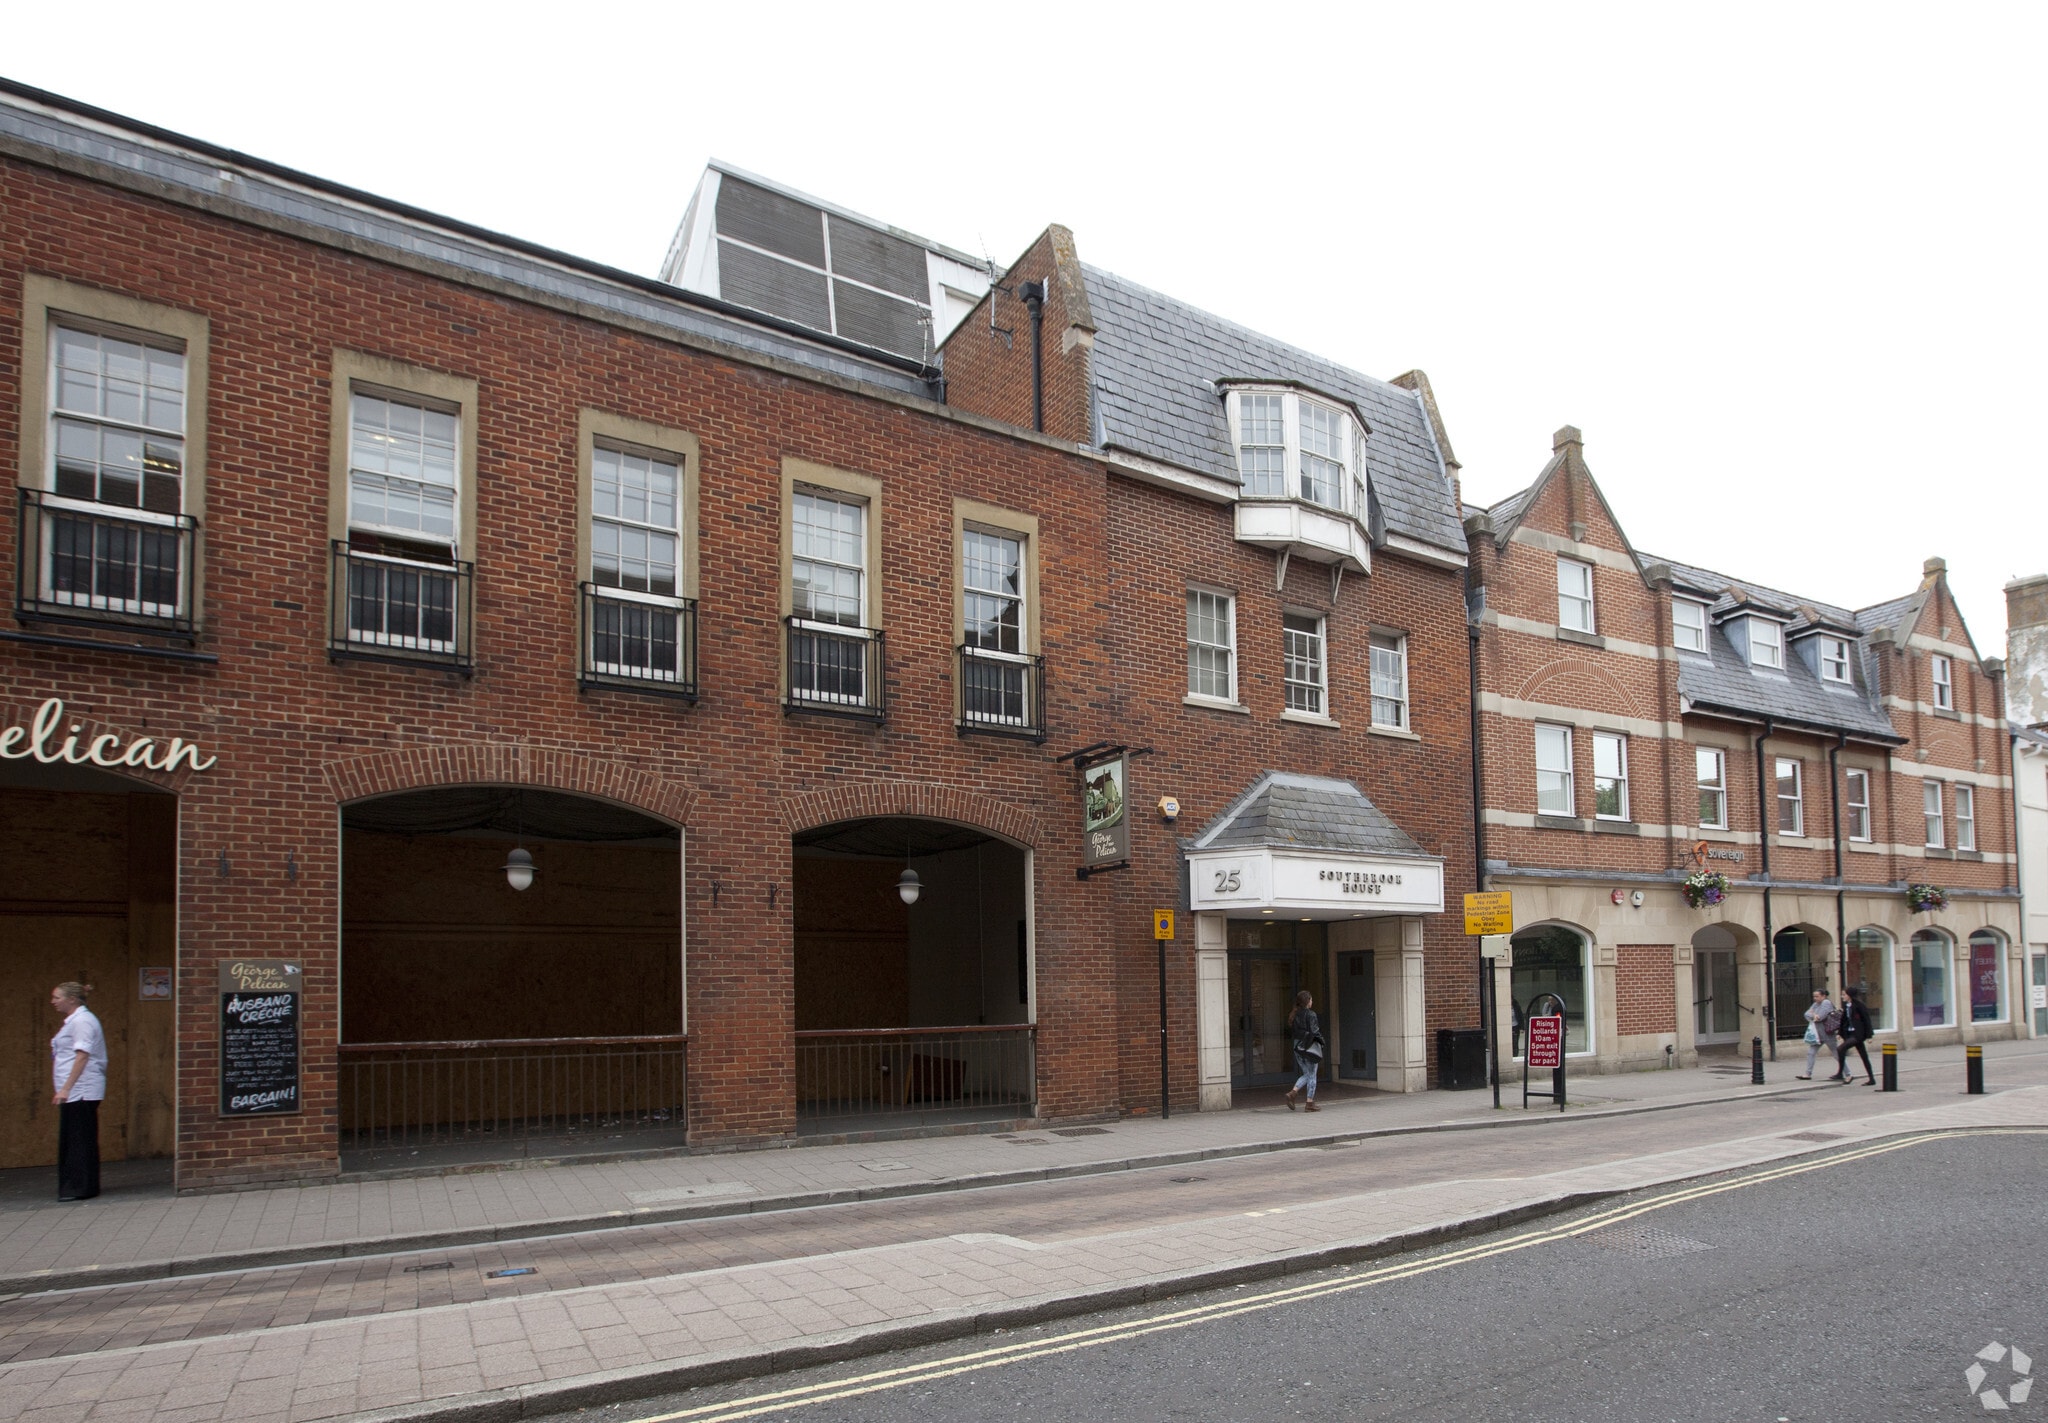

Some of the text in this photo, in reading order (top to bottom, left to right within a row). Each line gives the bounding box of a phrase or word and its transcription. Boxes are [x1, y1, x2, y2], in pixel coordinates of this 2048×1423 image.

[1708, 849, 1745, 863] sovereign
[1214, 869, 1241, 892] 25
[1319, 870, 1402, 884] SOUTHBROOK
[1343, 882, 1382, 895] HOUSE
[231, 963, 279, 979] George
[240, 976, 290, 990] Pelican
[226, 994, 292, 1014] HUSBAND
[230, 1085, 296, 1109] BARGAIN!
